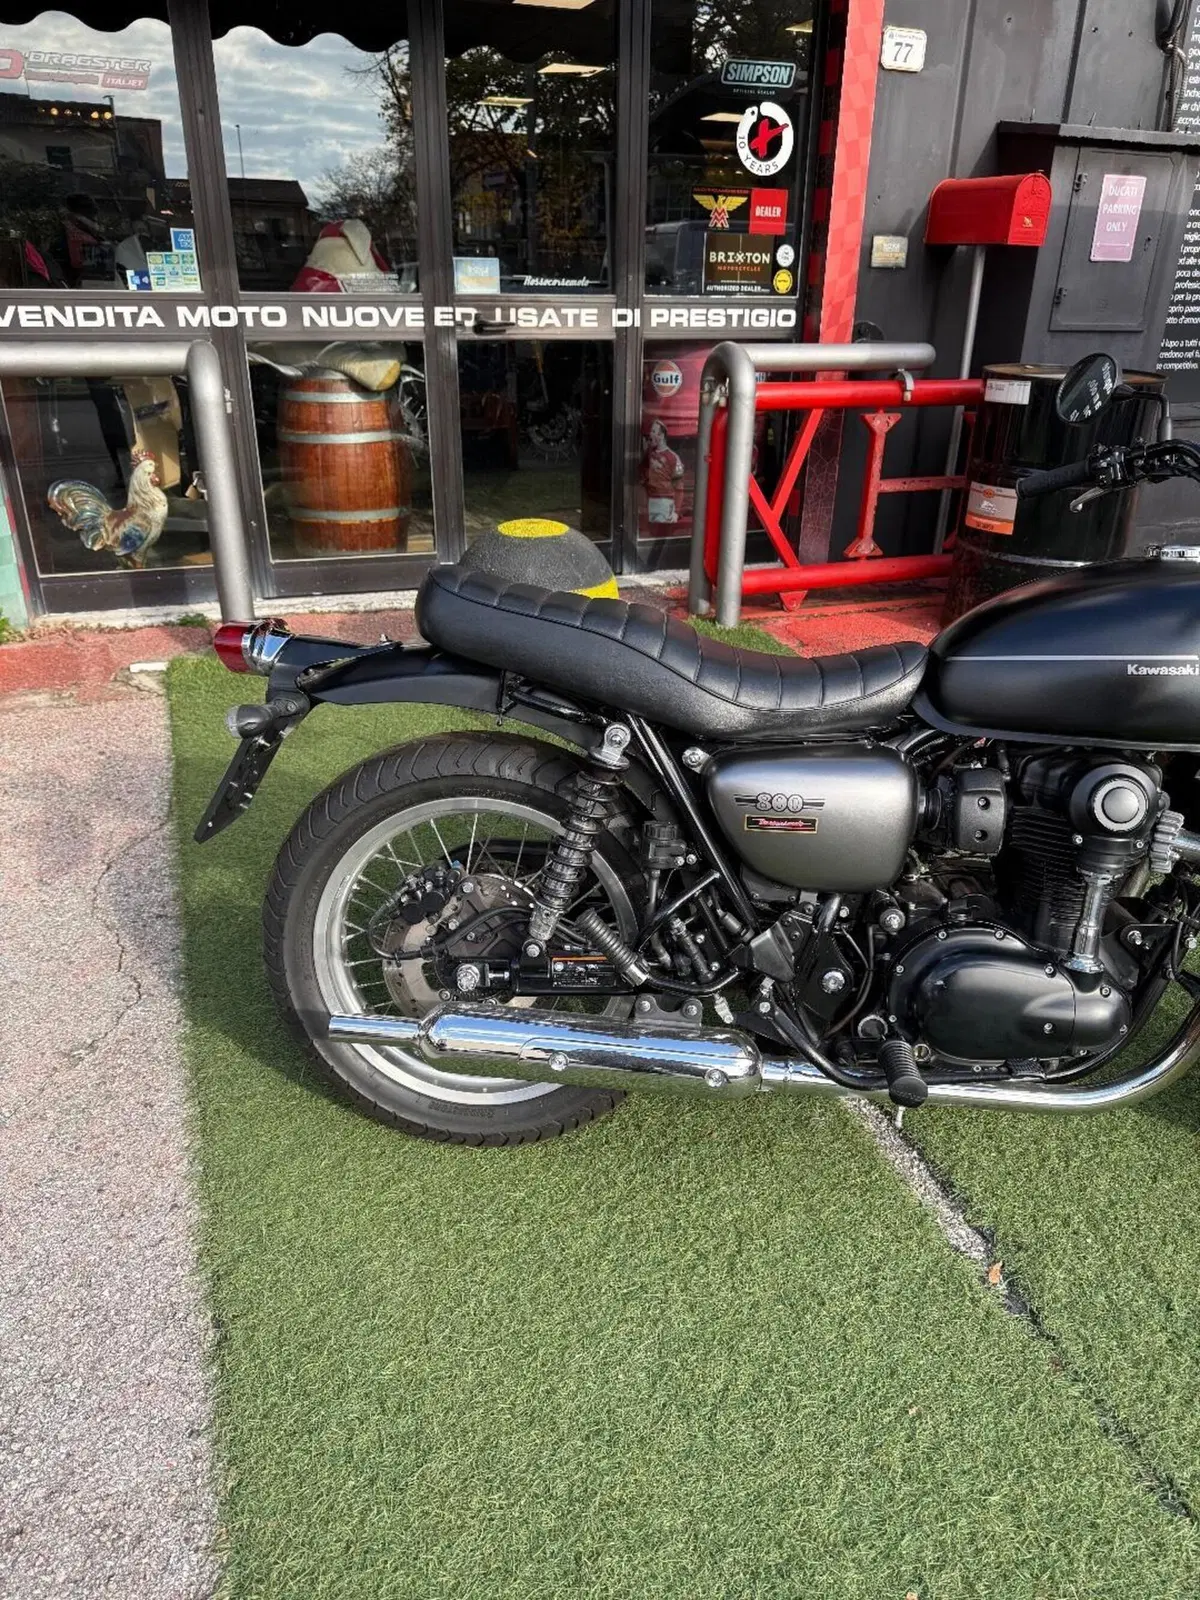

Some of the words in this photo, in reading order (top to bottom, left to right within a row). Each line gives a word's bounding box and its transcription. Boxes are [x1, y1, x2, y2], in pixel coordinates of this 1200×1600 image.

[893, 41, 914, 63] 77
[26, 51, 152, 72] DRAGSTER
[726, 62, 790, 84] SIMPSON
[743, 153, 779, 174] YEARS
[1108, 184, 1138, 197] DUCATI
[755, 205, 782, 218] DEALER
[1101, 202, 1138, 216] PARKING
[1106, 220, 1128, 232] ONLY
[709, 251, 770, 264] BRIXTON
[717, 264, 761, 272] MOTORCYCLES
[706, 284, 740, 292] AUTHORIZED
[741, 285, 762, 293] DEALER
[0, 305, 165, 327] VENDITA
[176, 306, 287, 327] MOTO
[301, 306, 425, 327] NUOVE
[433, 307, 479, 328] ED
[494, 307, 598, 327] USATE
[611, 308, 641, 327] DI
[650, 308, 797, 327] PRESTIGIO
[653, 373, 680, 384] Gulf
[1127, 664, 1200, 676] Kawasaki
[756, 792, 804, 814] 800
